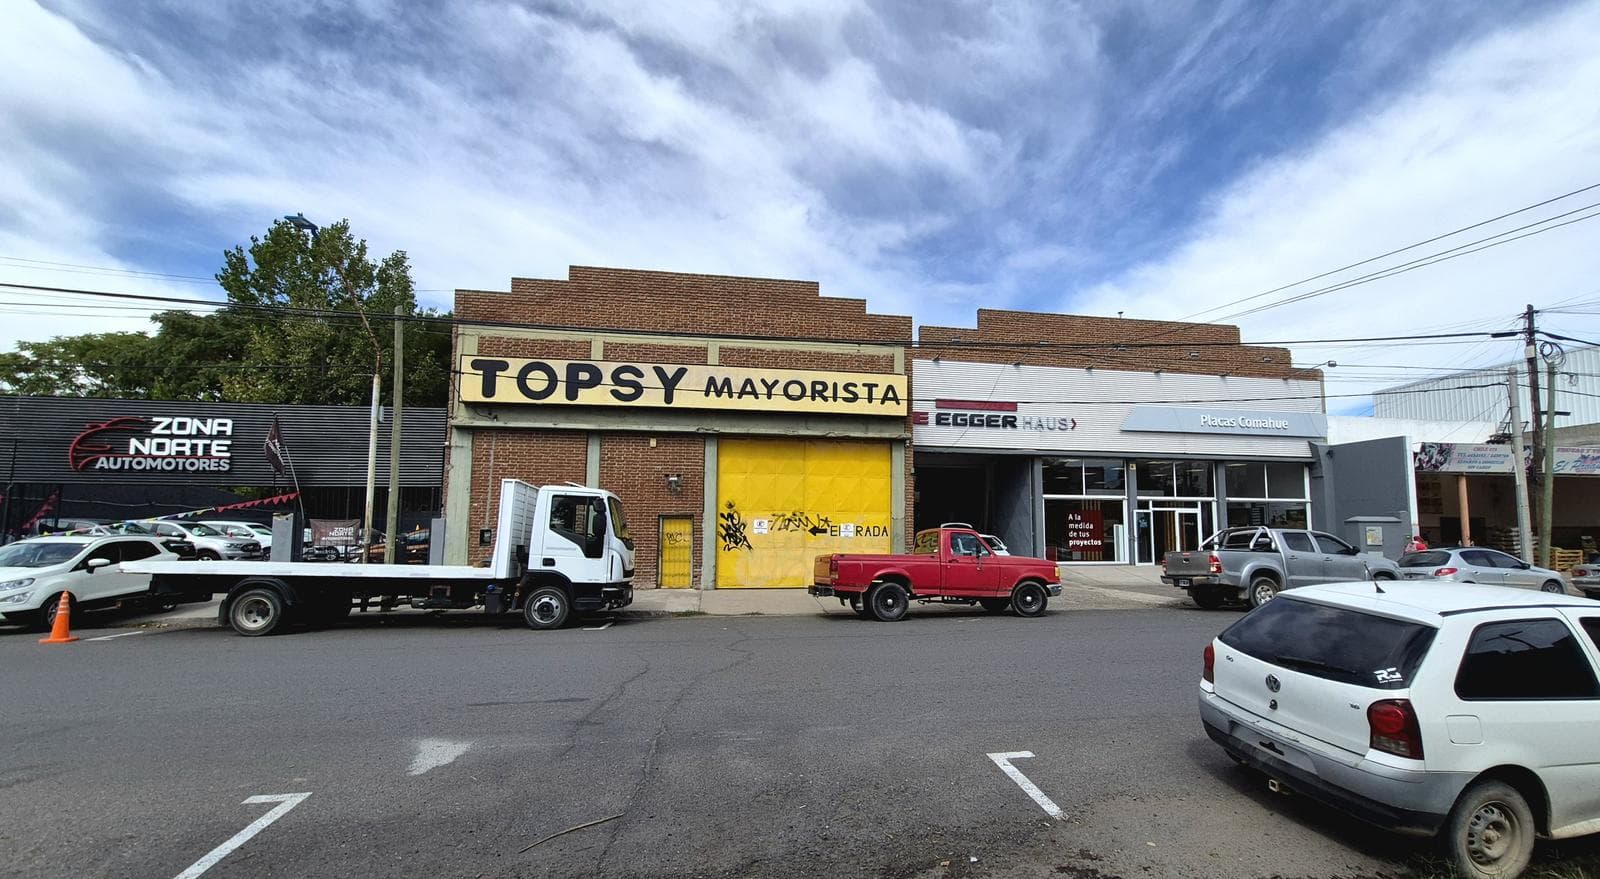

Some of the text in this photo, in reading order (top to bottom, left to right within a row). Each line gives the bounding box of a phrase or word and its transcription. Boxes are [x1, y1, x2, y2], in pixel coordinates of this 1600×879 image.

[470, 359, 901, 406] TOPSY MAYORISTA
[151, 417, 233, 436] ZONA
[935, 412, 1018, 429] EGGER
[1022, 415, 1068, 431] HAUS
[1200, 414, 1289, 430] Placas Comahue
[128, 437, 232, 457] NORTE
[95, 457, 231, 471] AUTOMOTORES
[830, 525, 889, 537] ERADA
[1068, 530, 1090, 538] de tus
[1068, 539, 1102, 548] proyectos
